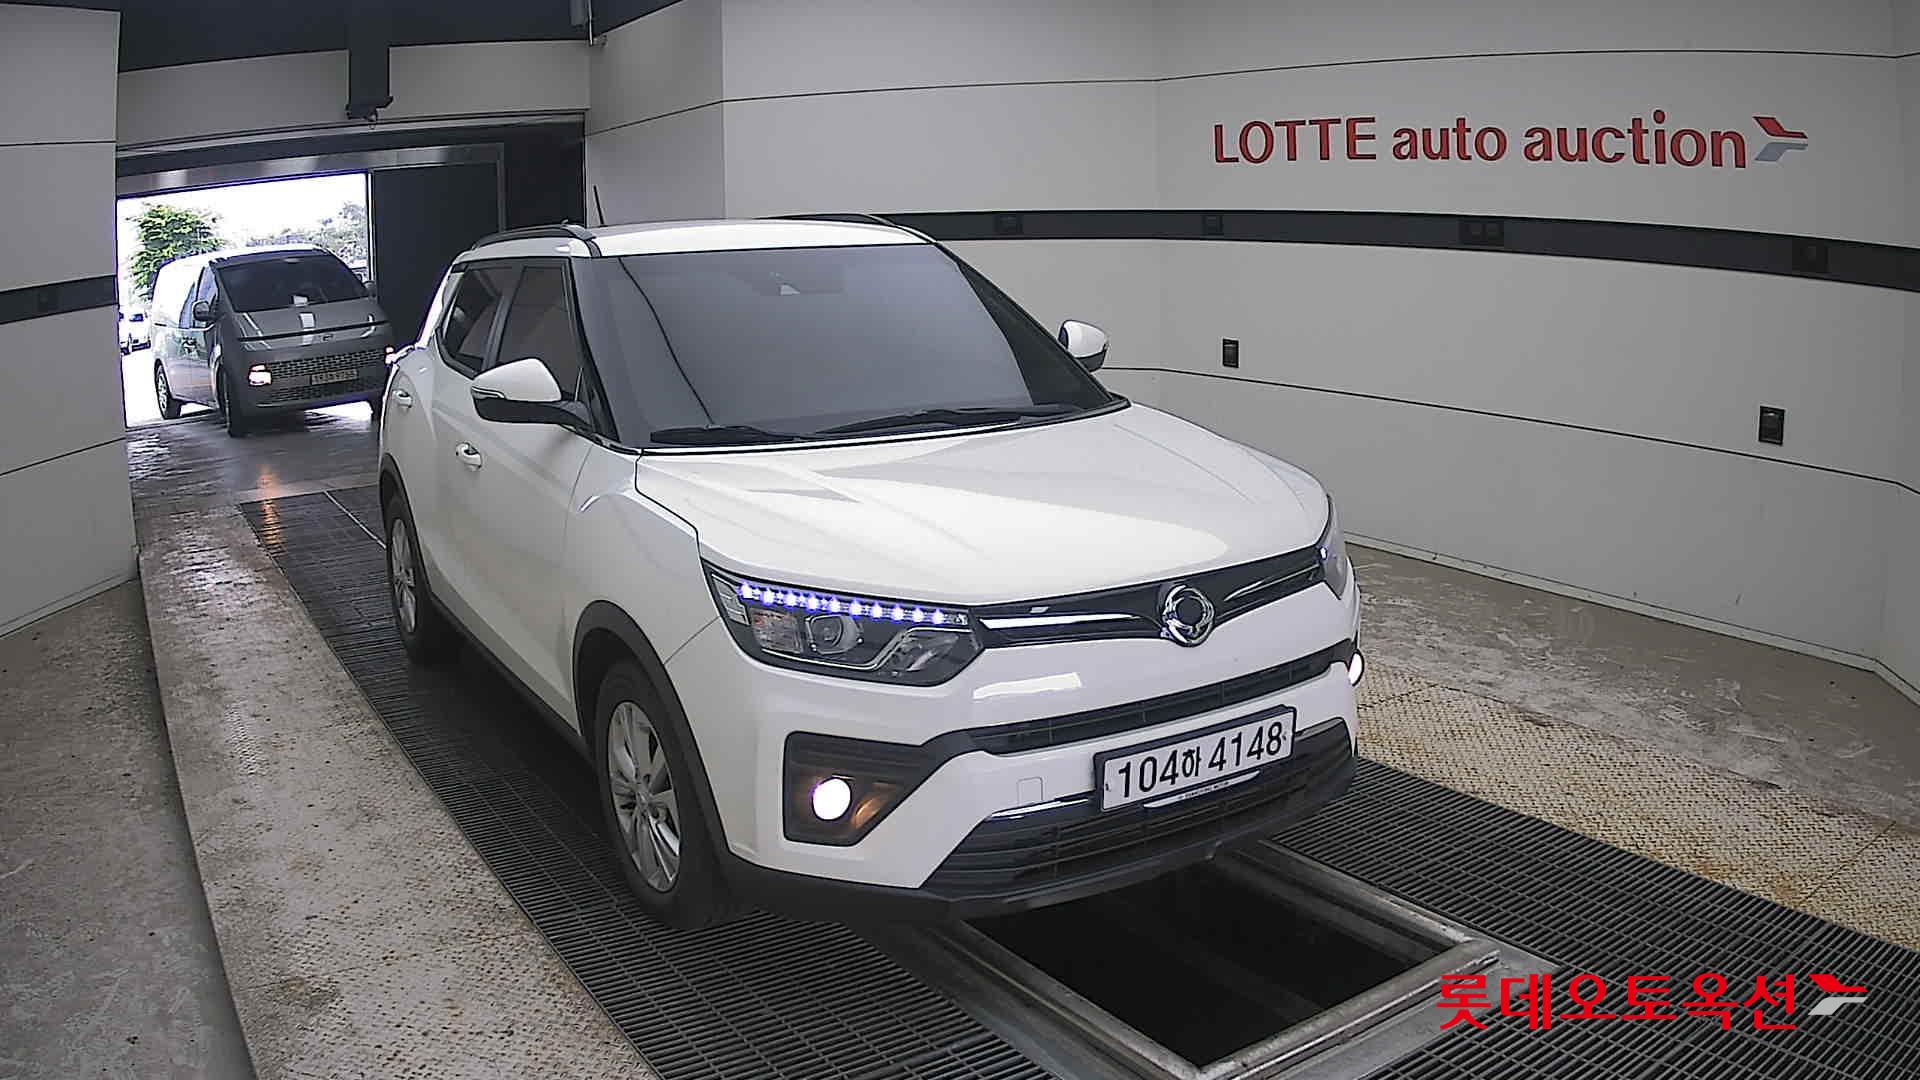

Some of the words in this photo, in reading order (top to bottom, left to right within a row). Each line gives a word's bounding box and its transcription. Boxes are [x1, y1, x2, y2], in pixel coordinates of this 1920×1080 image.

[1213, 117, 1377, 165] LOTTE
[1393, 117, 1508, 162] auto
[1523, 109, 1747, 168] auction
[1118, 746, 1202, 798] 104하
[1208, 721, 1283, 771] 4148
